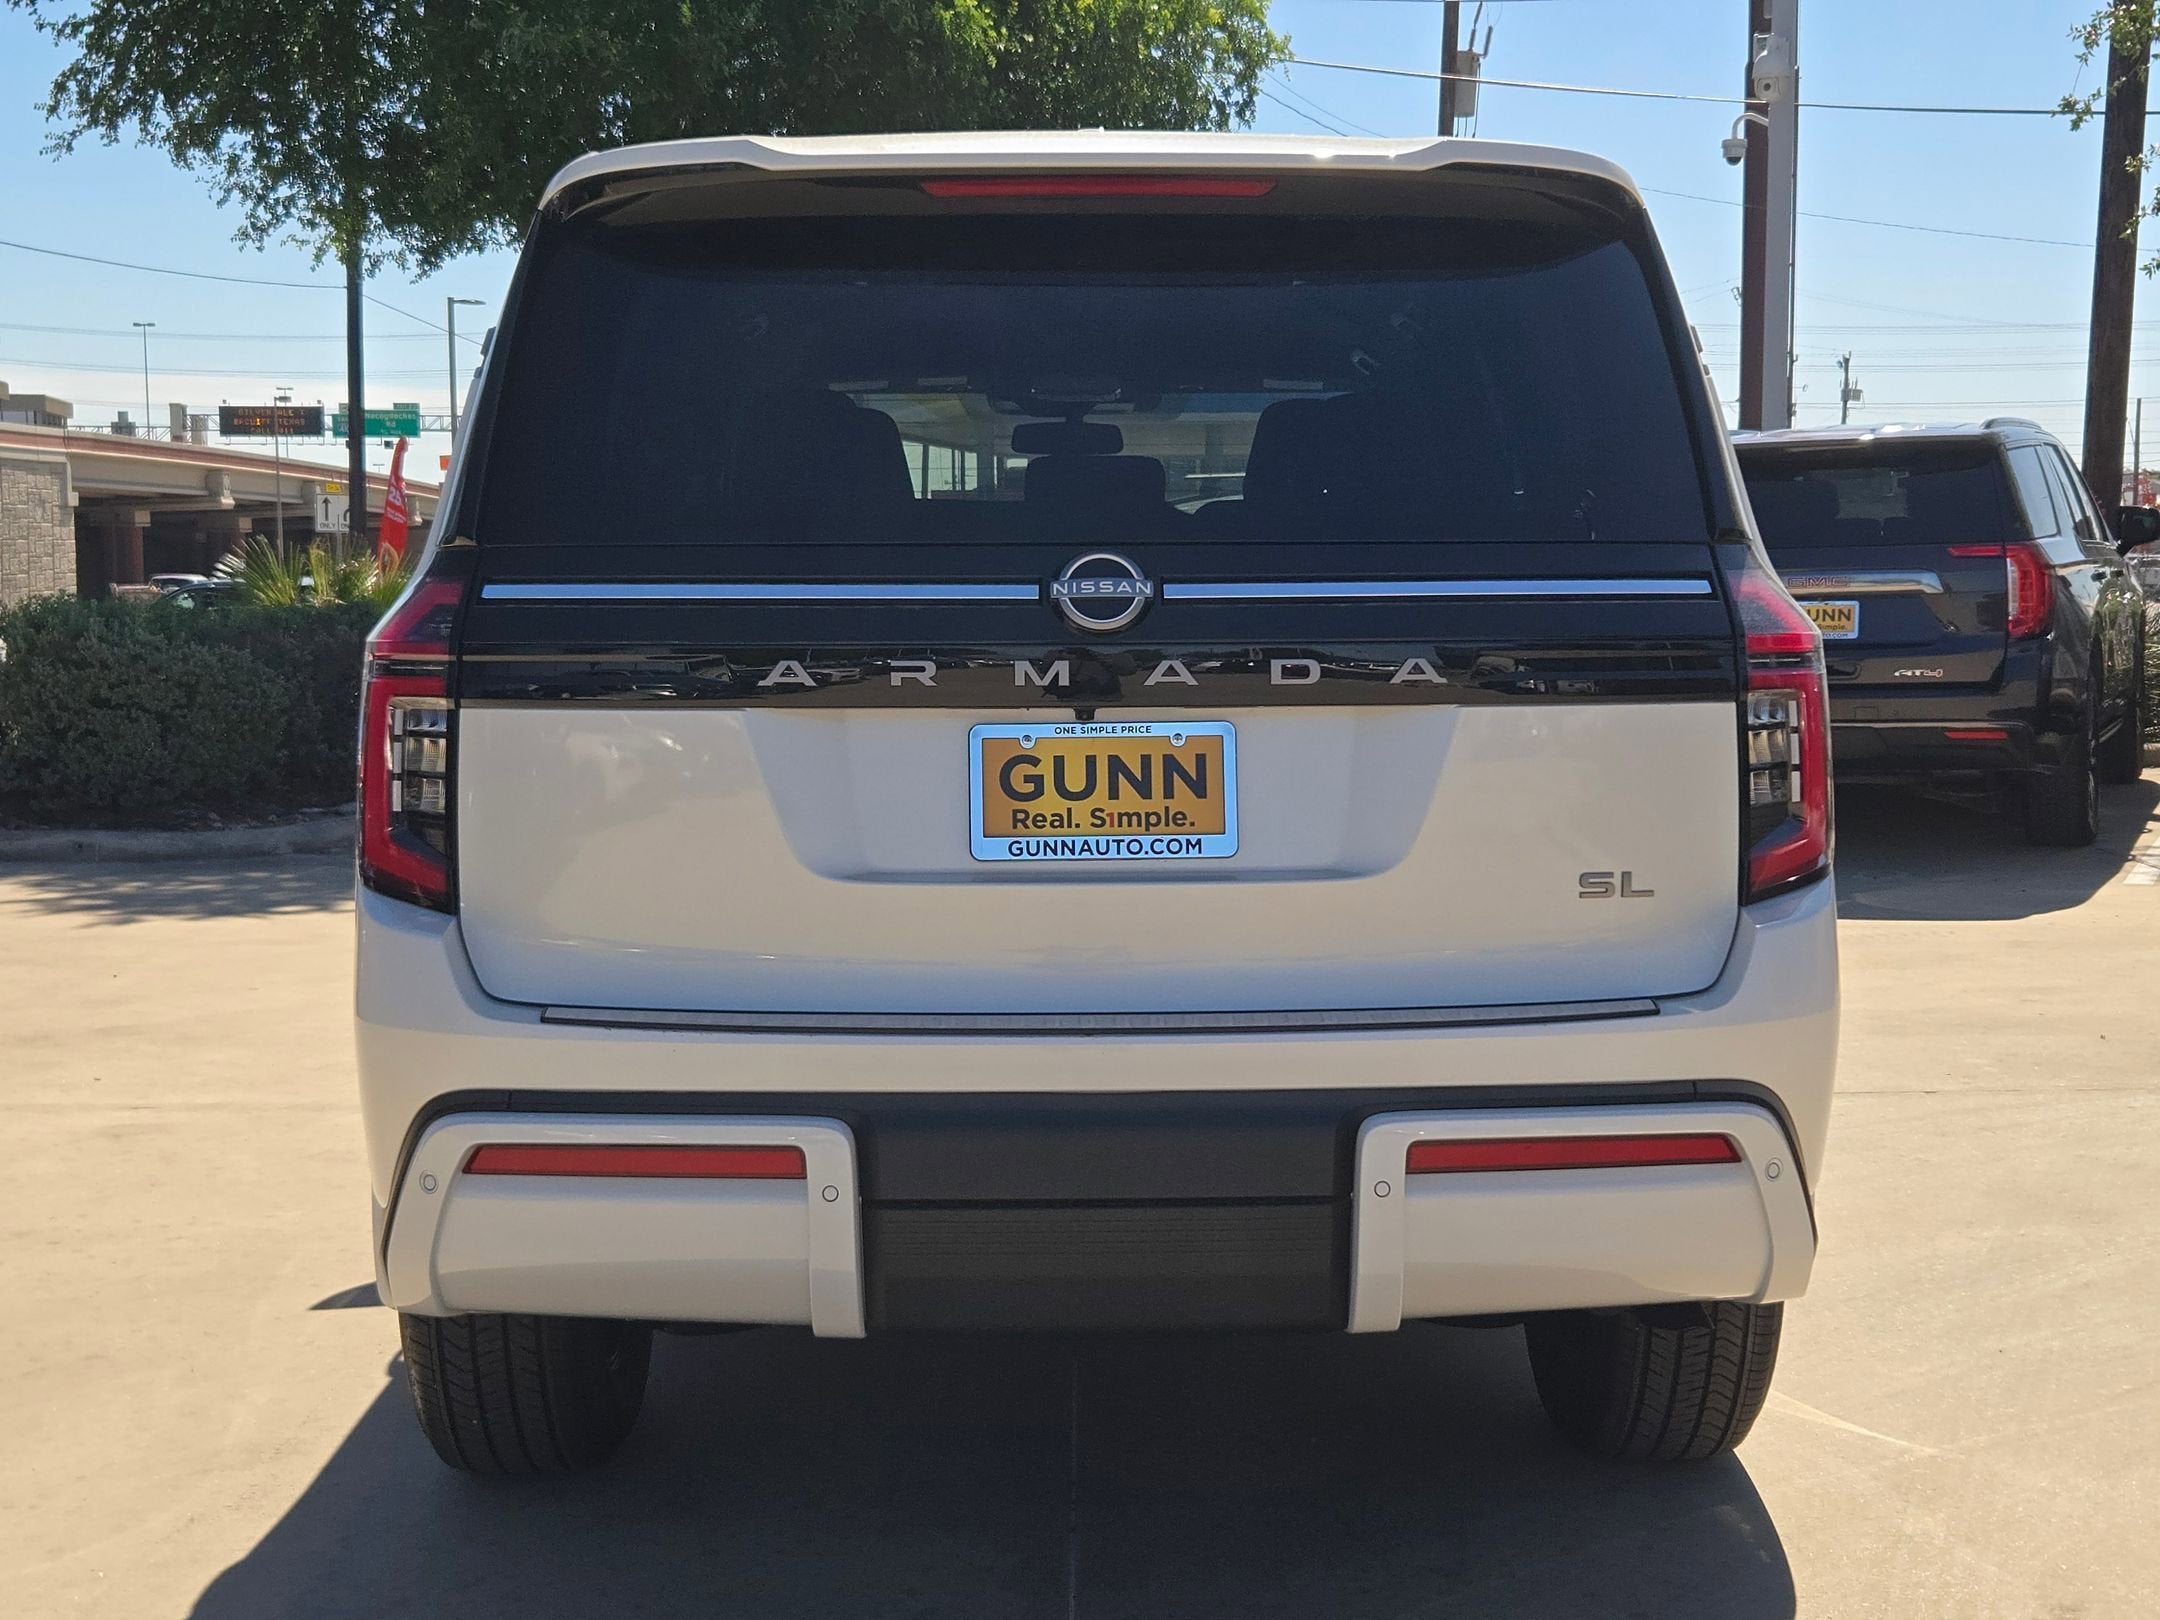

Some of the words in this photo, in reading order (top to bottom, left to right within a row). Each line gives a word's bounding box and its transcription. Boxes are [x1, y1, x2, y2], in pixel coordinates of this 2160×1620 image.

[1051, 580, 1152, 596] NISSAN
[1787, 576, 1849, 588] GMC
[1807, 608, 1852, 622] UNN
[757, 658, 1448, 688] ARMADA
[1894, 668, 1944, 678] AT4
[1054, 726, 1077, 735] ONE
[1080, 725, 1118, 735] SIMPLE
[1120, 725, 1152, 734] PRICE
[999, 753, 1207, 802] GUNN
[1012, 807, 1081, 830] Real.
[1008, 838, 1202, 857] GUNNAUTO.COM
[1579, 871, 1655, 898] SL
